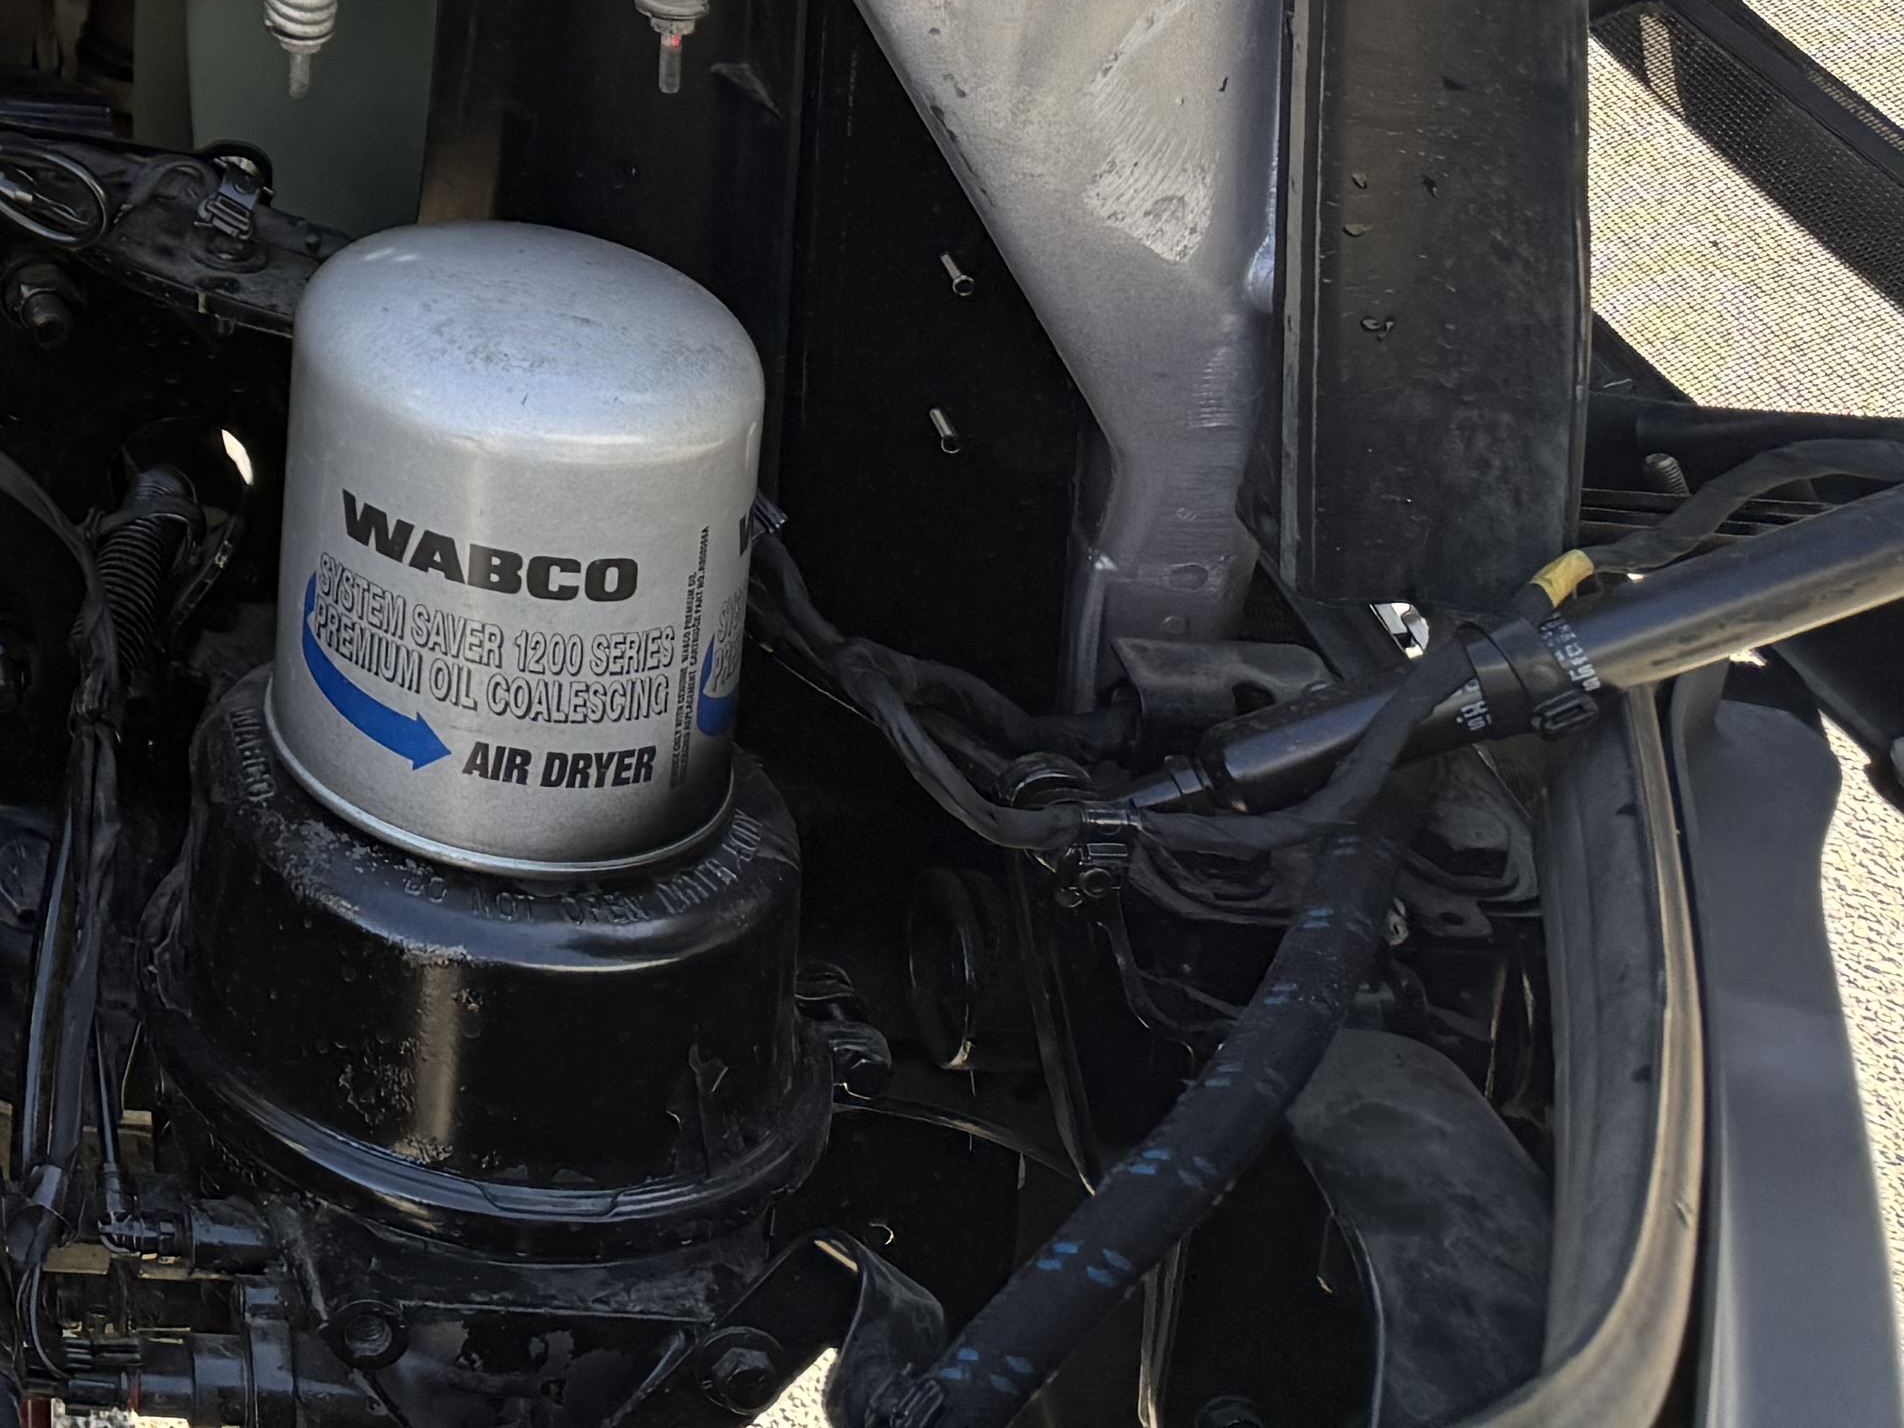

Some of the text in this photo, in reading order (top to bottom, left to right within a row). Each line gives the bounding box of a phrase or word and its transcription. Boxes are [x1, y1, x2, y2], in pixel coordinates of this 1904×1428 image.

[342, 488, 638, 602] WABCO
[316, 596, 669, 724] PREMIUM OIL COALESCING
[319, 552, 675, 676] SYSTEM SAVER 1200 SERIES
[462, 741, 532, 785] AIR
[540, 746, 656, 788] DRYER
[471, 891, 535, 923] NOT
